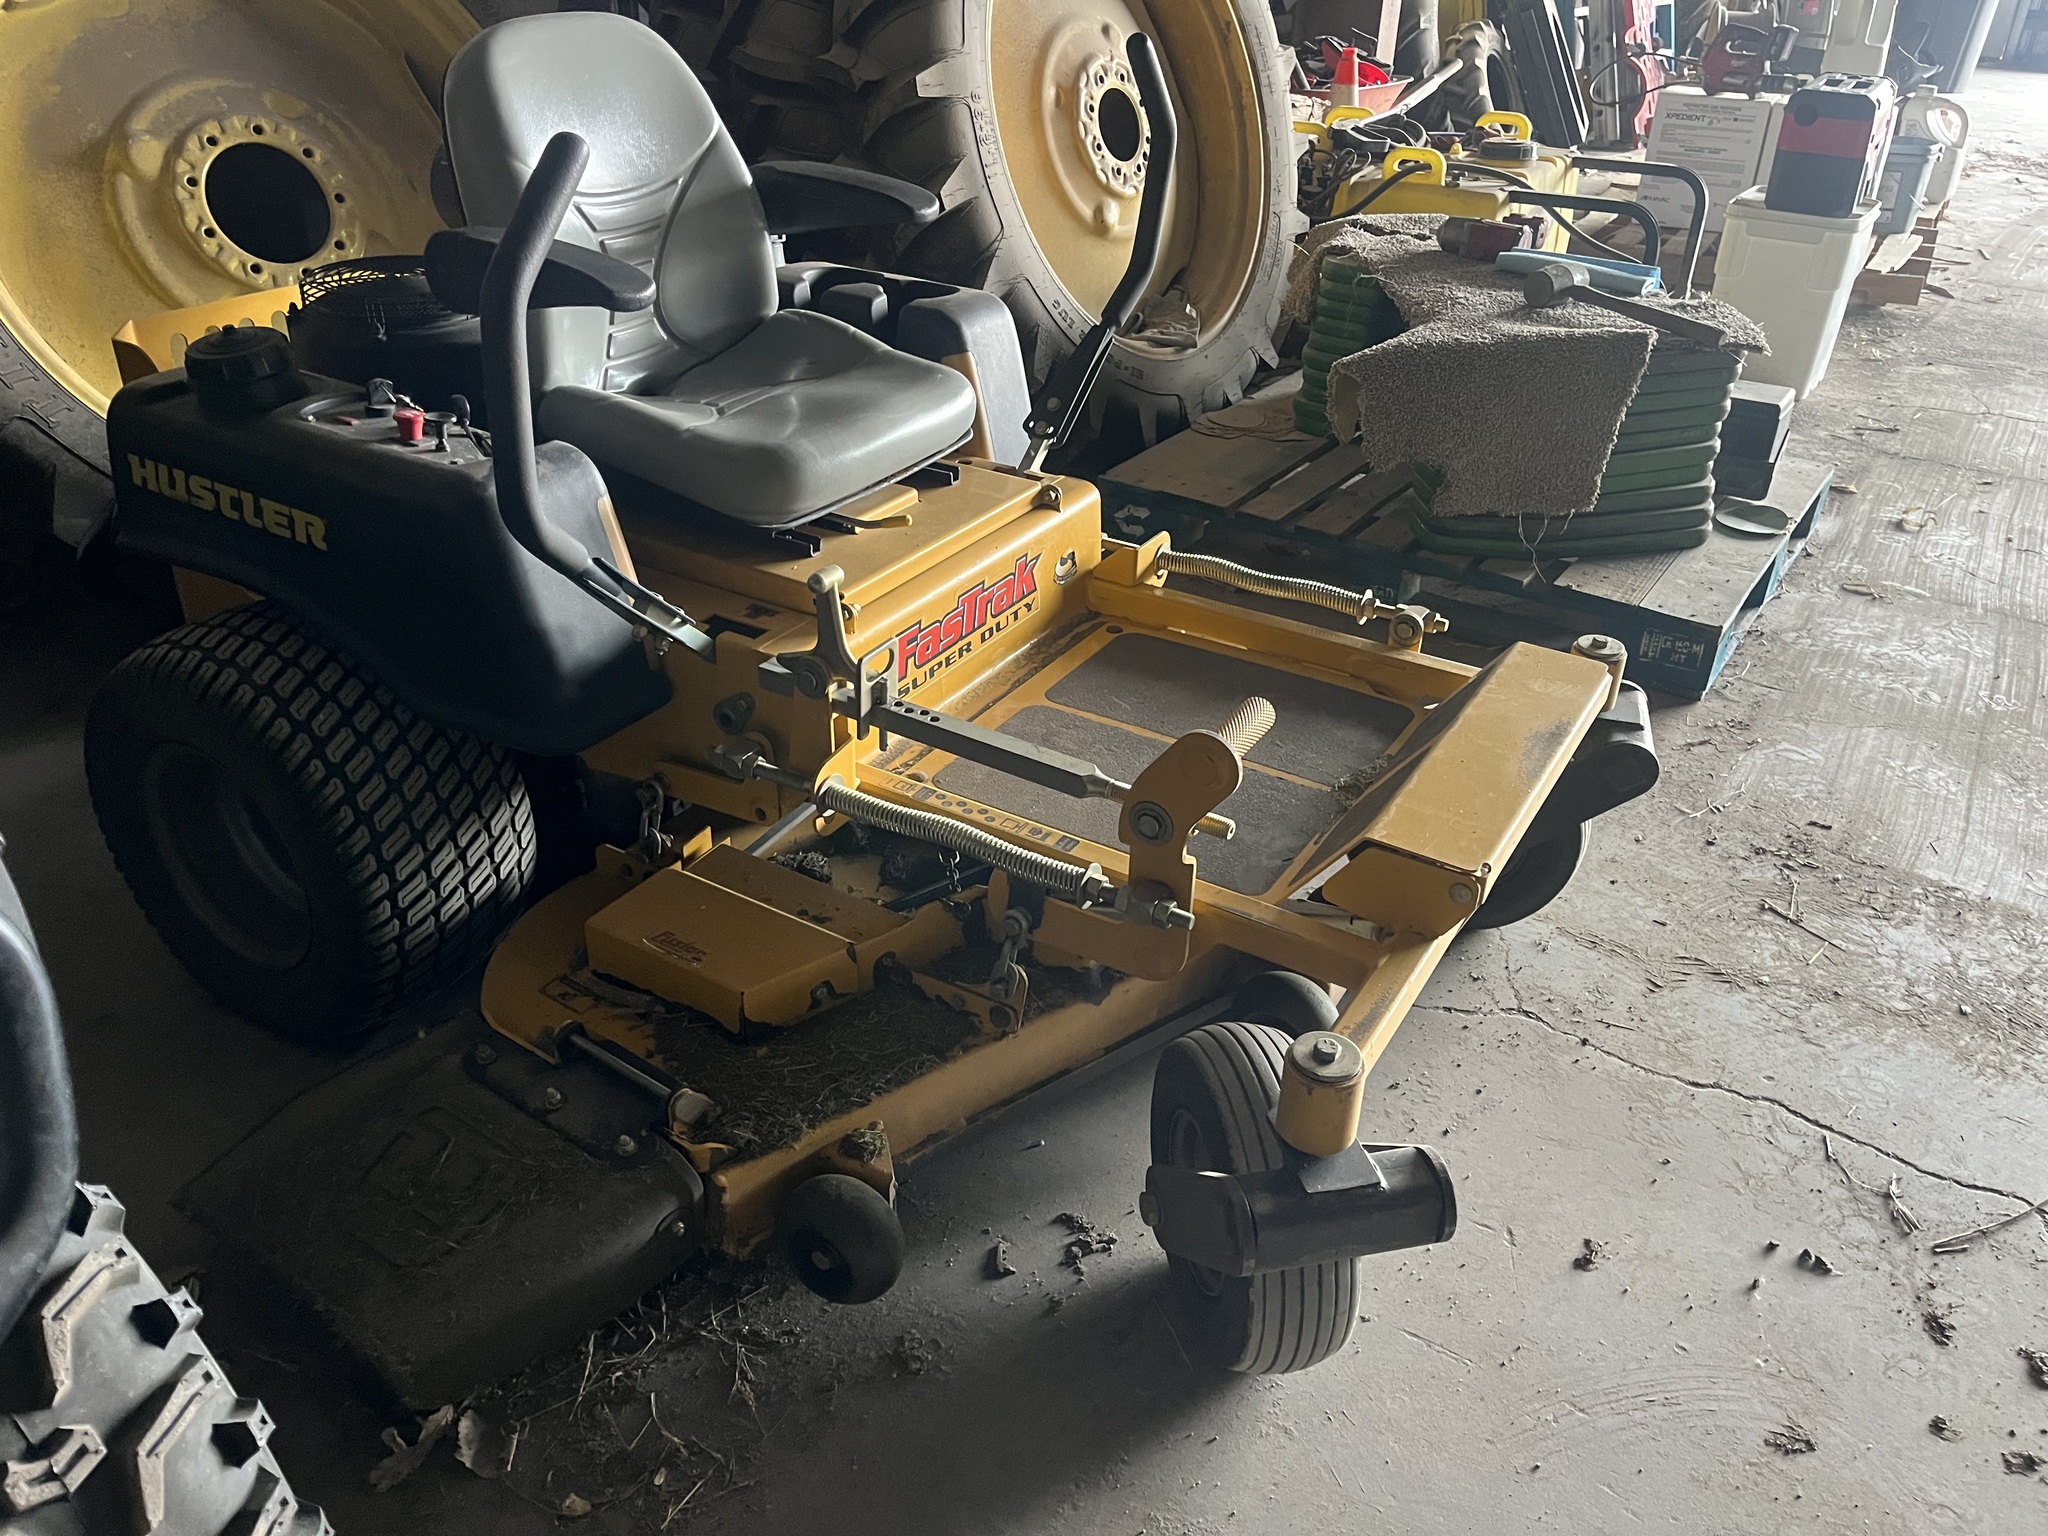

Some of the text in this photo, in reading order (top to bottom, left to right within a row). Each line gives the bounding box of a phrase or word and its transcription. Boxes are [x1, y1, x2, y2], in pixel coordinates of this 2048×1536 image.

[127, 453, 328, 551] HUSTLER
[896, 551, 1043, 683] FasTrak
[898, 597, 1037, 698] SUPER DUTY
